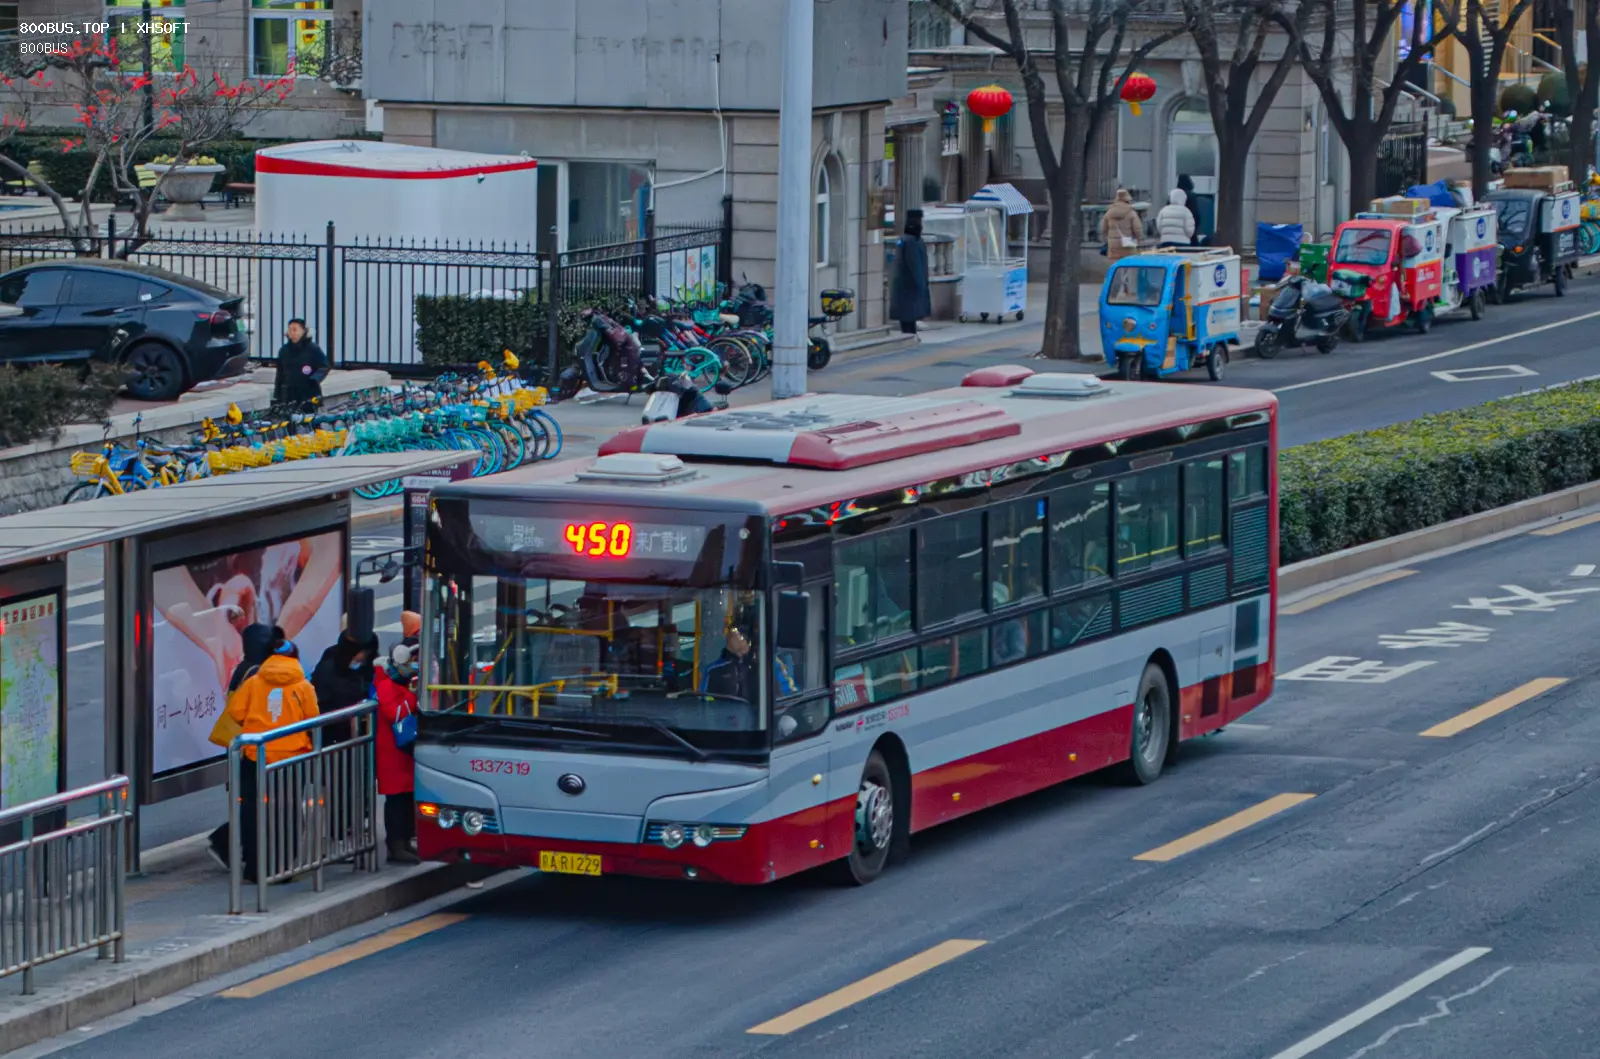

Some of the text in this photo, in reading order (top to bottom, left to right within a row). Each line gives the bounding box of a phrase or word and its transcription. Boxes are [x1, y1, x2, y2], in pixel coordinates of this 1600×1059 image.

[566, 522, 632, 557] 450
[635, 530, 688, 553] 来广营北
[1275, 564, 1600, 684] 交专用
[156, 689, 217, 729] 同一个地球
[468, 759, 531, 776] 1337319
